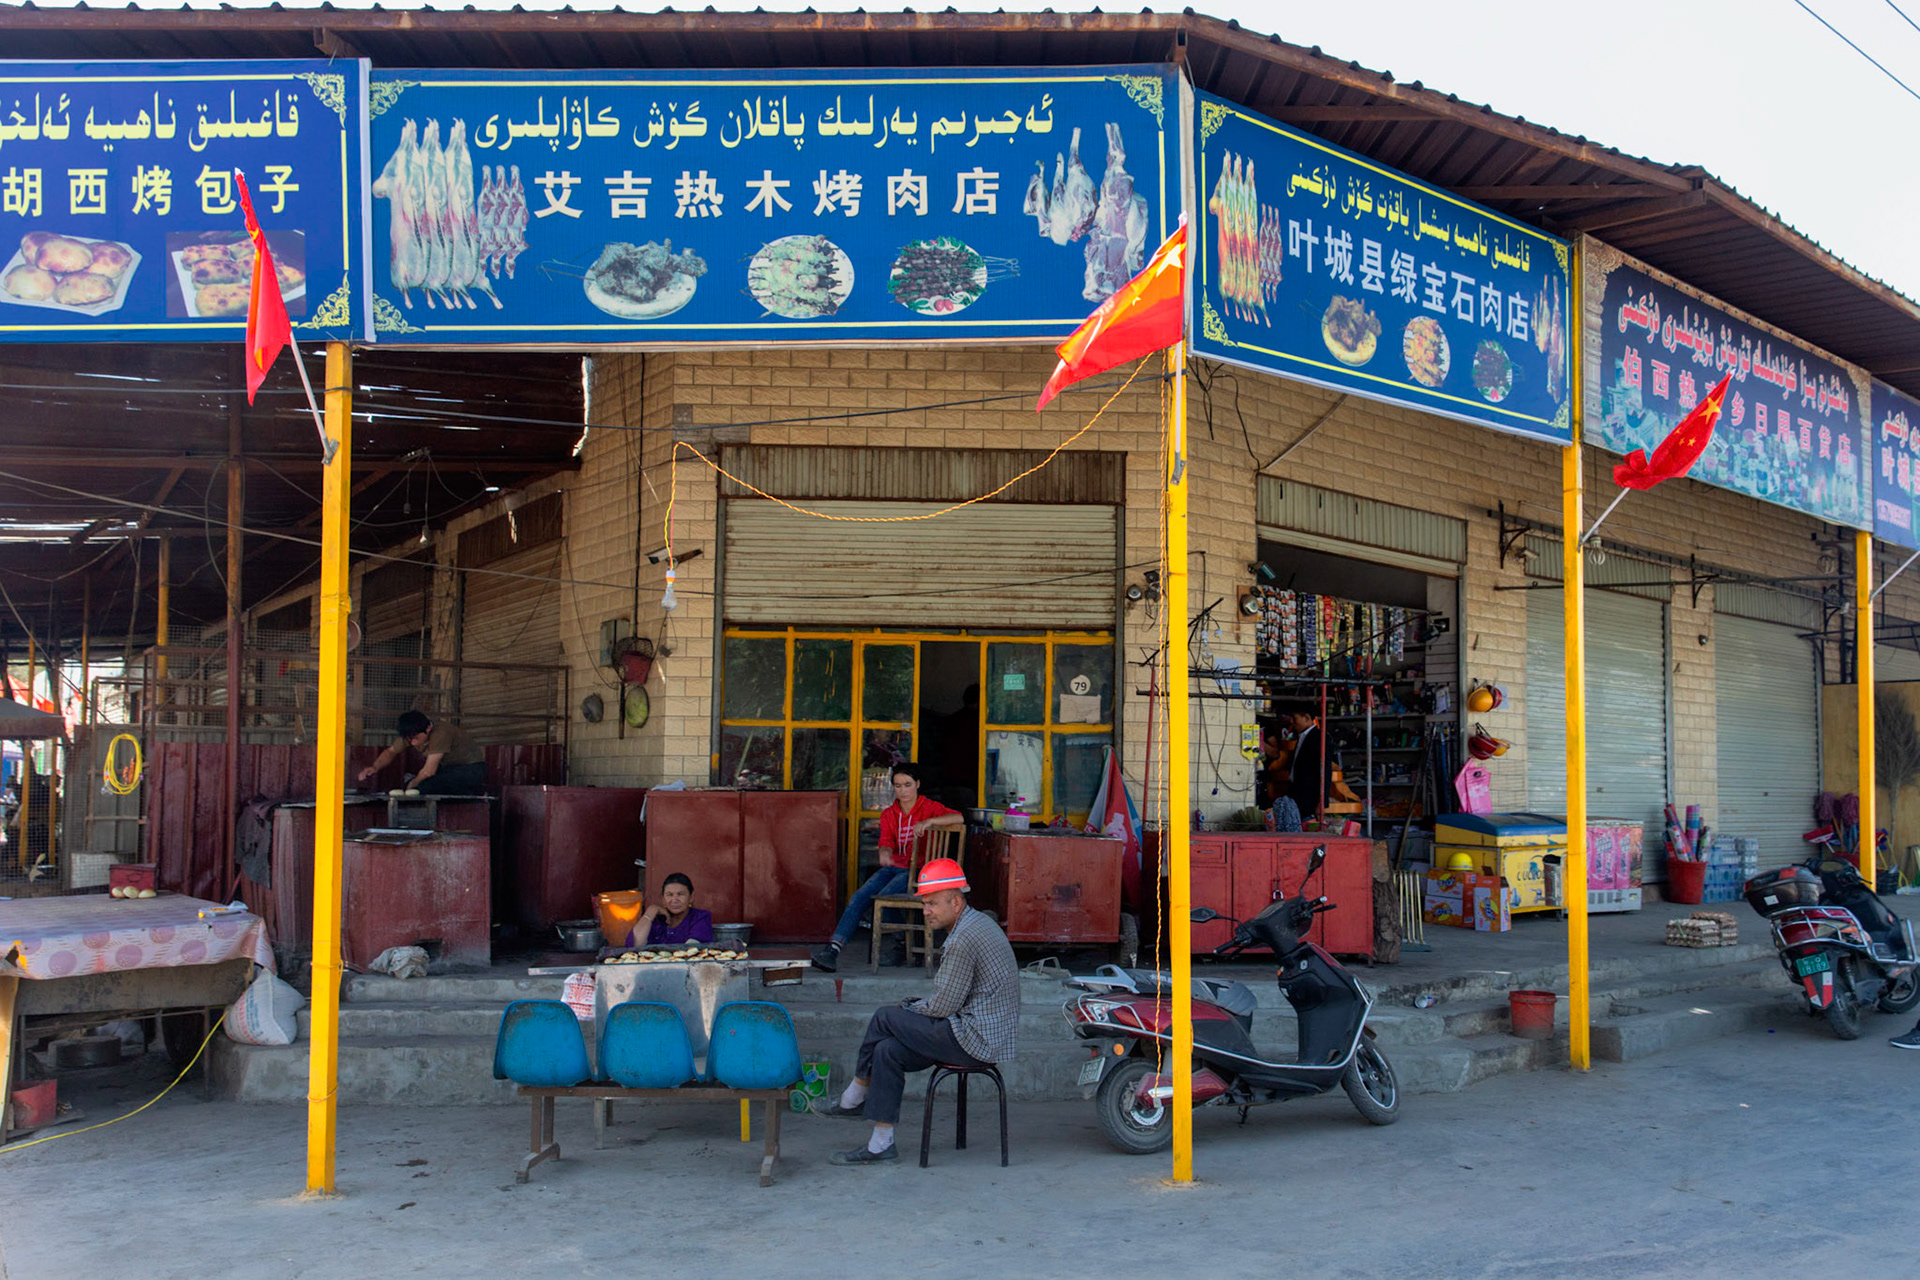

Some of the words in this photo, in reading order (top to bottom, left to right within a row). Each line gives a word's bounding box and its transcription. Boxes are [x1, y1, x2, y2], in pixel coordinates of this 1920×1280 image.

[2, 165, 299, 217] 胡西烤包子
[534, 166, 1000, 218] 艾吉热木烤肉店
[1288, 218, 1530, 342] 叶城县绿宝石肉店
[1623, 345, 1851, 466] 伯西热乡日用百货店
[1074, 682, 1087, 691] 79
